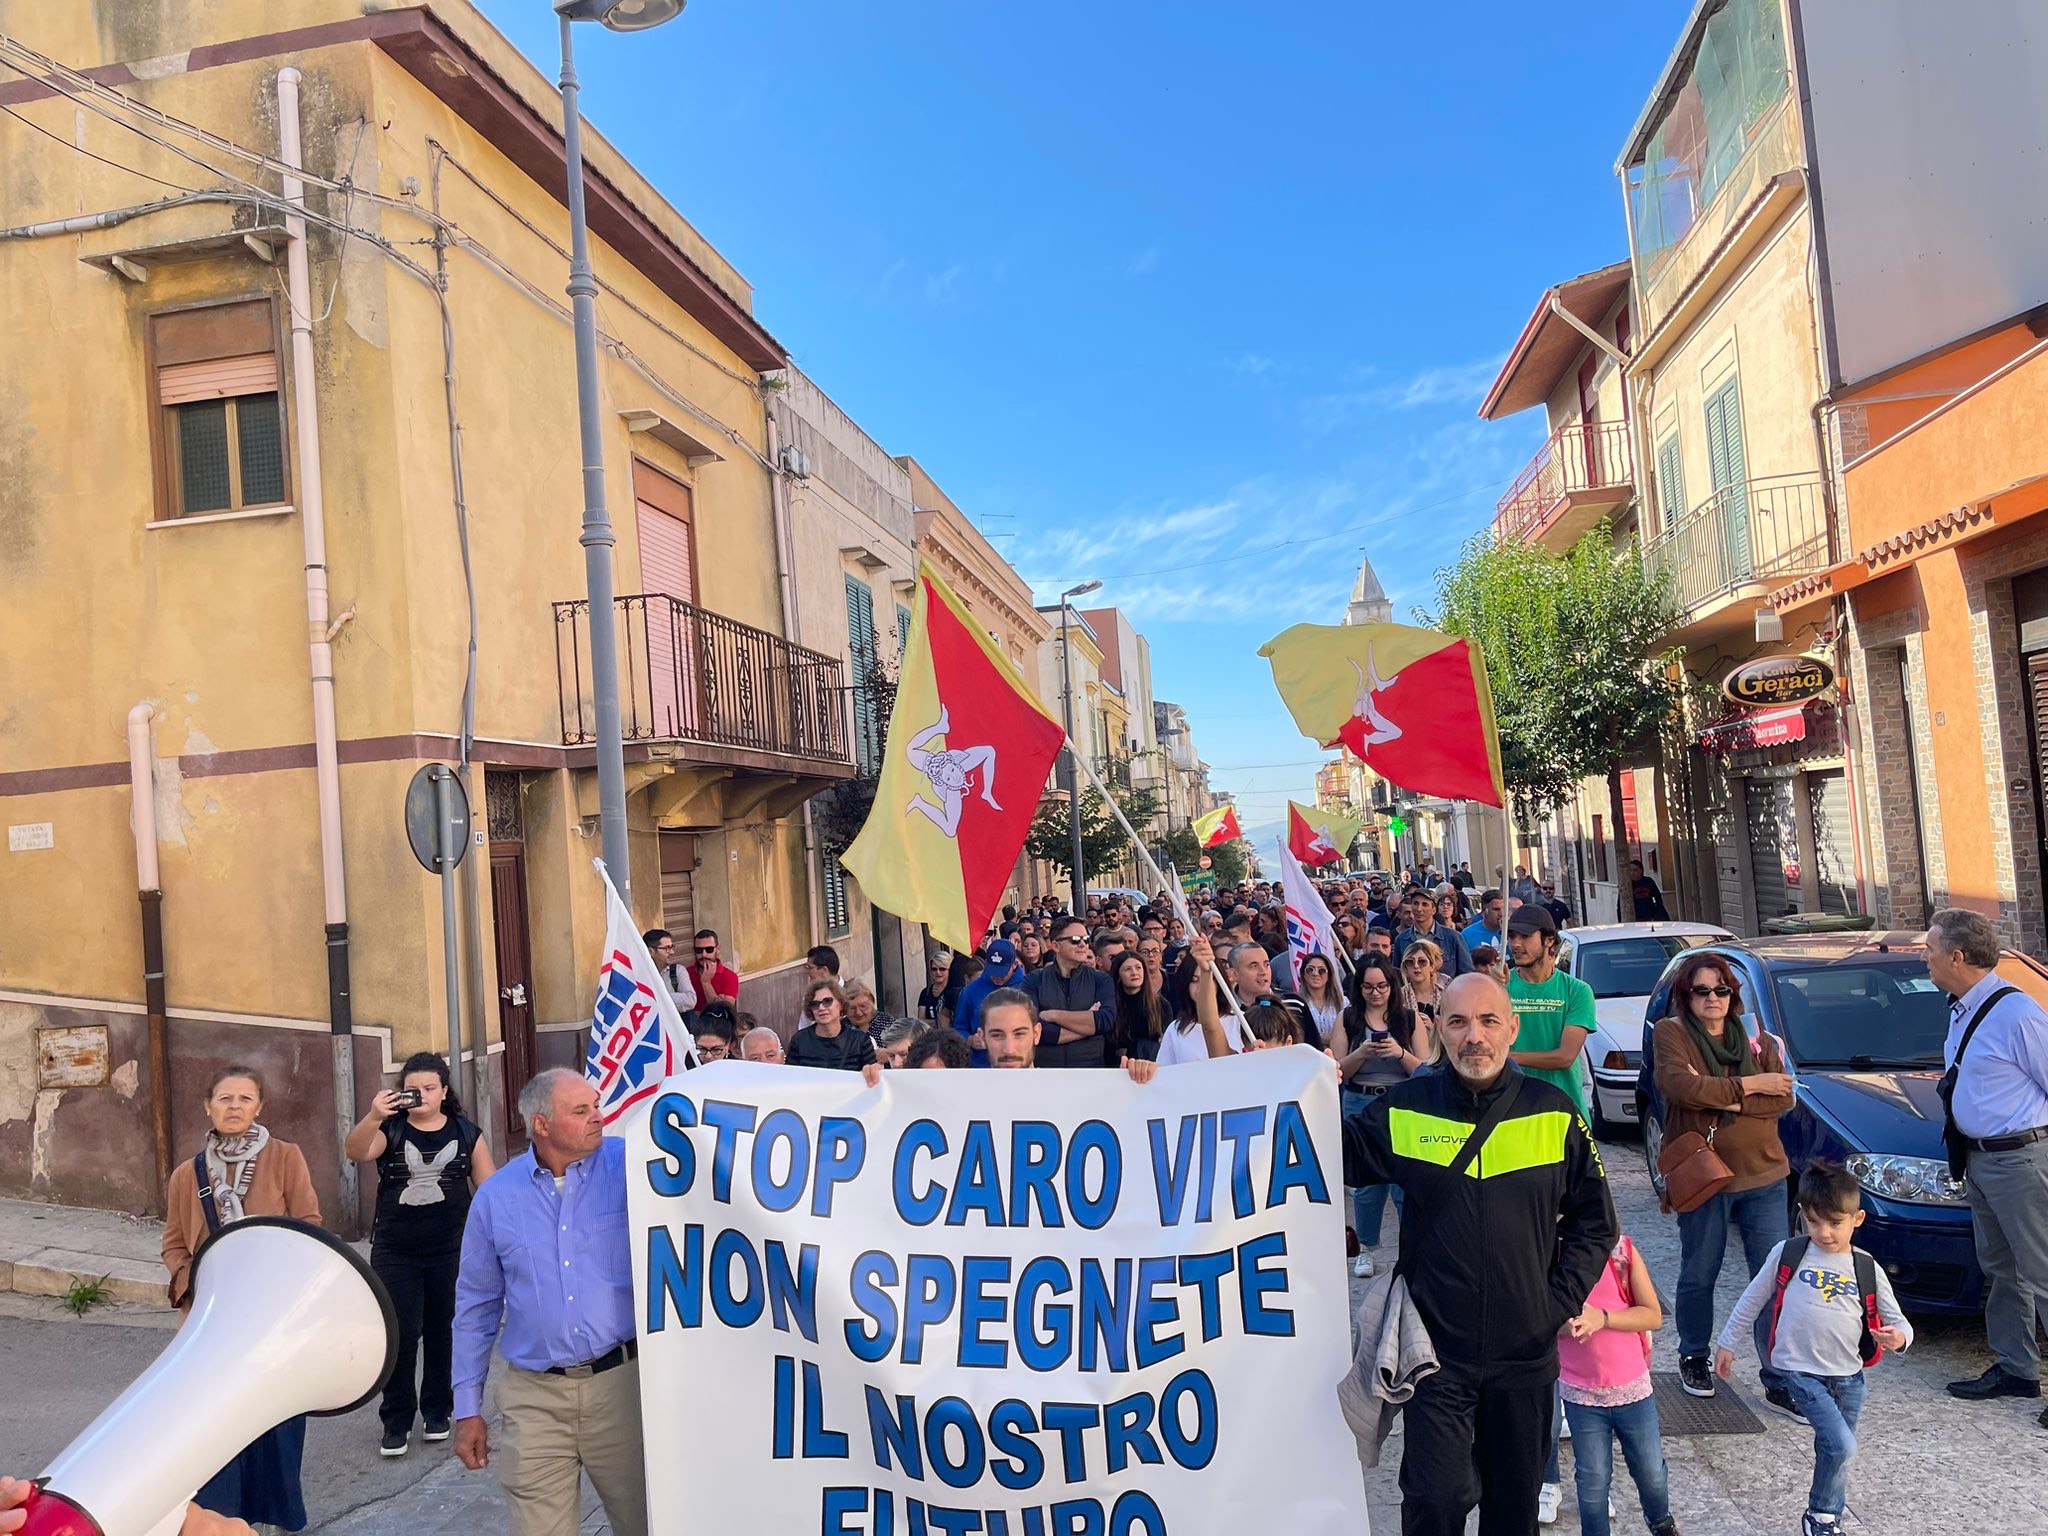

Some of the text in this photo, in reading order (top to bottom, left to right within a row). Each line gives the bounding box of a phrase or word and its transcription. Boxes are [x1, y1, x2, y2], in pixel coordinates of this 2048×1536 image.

[1737, 670, 1824, 696] Geraci
[1776, 689, 1793, 697] Bar
[646, 1092, 1332, 1231] STOP CARO VITA
[646, 1223, 1296, 1373] NON SPEGNETE
[1798, 1269, 1858, 1296] GUESS
[772, 1355, 1219, 1491] IL NOSTRO
